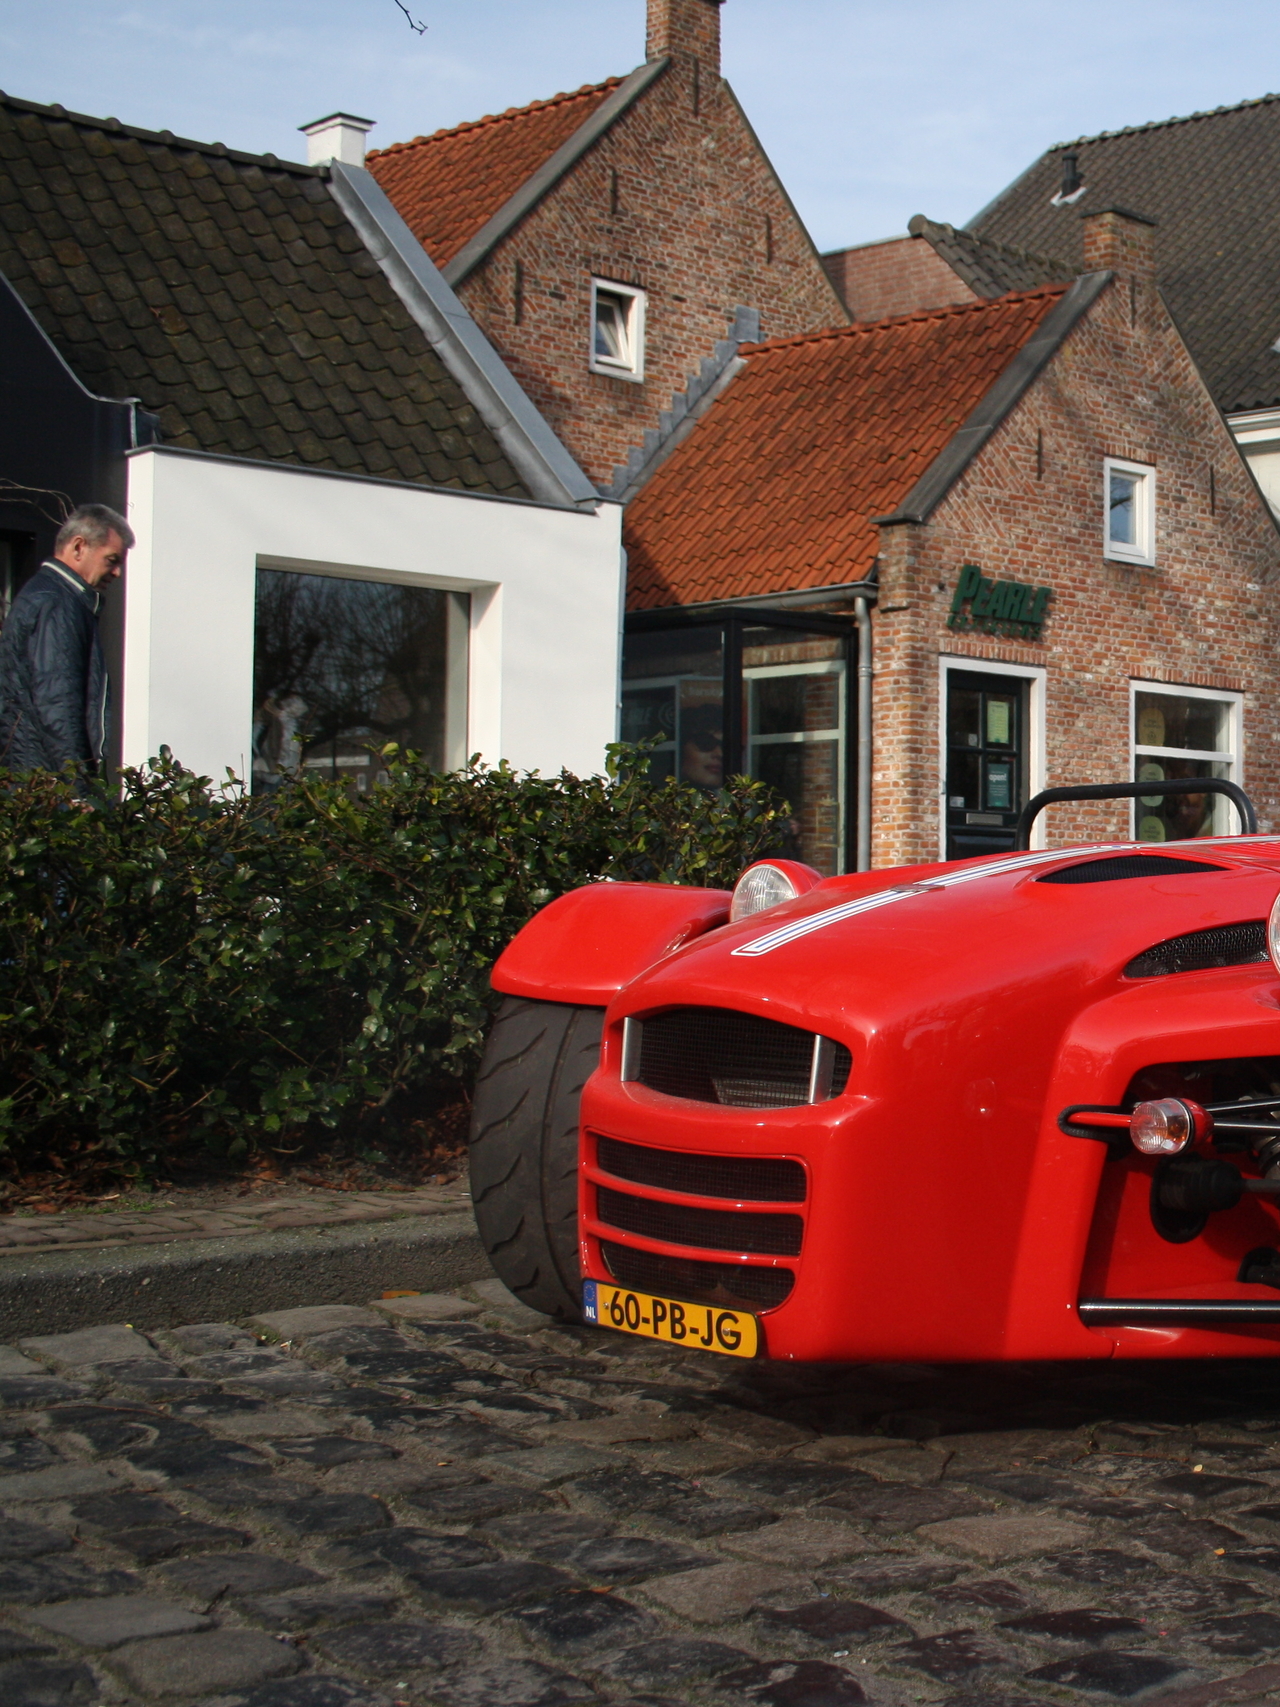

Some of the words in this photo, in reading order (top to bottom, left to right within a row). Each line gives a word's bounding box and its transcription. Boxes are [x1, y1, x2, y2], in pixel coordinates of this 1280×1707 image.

[950, 563, 1052, 624] PEARLE
[585, 1305, 596, 1319] NL
[610, 1290, 742, 1351] 60-PB-JG
